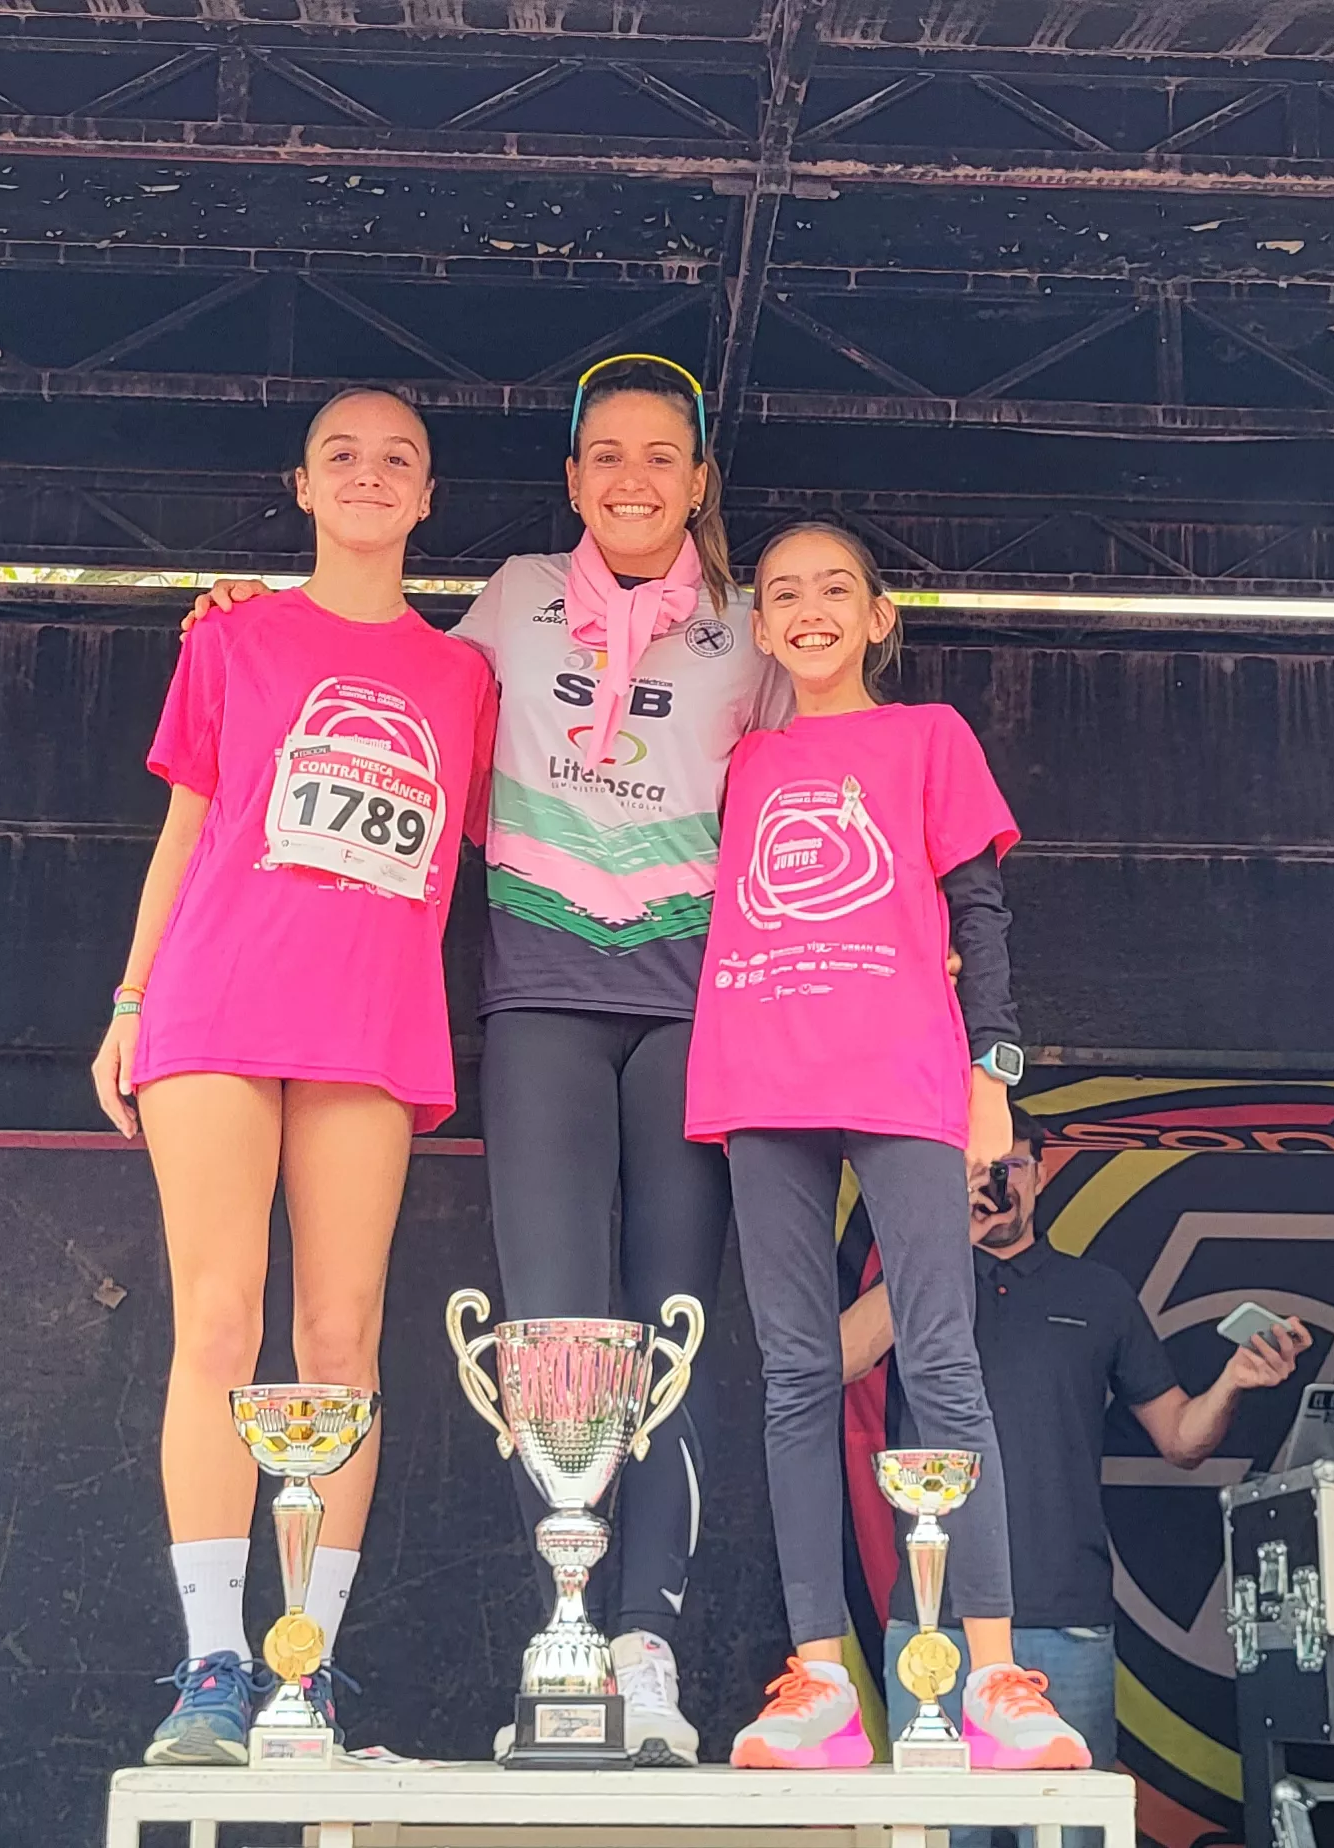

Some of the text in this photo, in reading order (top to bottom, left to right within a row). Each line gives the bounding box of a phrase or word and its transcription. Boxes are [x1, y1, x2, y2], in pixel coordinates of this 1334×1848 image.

[553, 672, 673, 718] SB
[298, 760, 432, 807] CONTRA EL CÁNCER
[351, 756, 393, 777] HUESCA
[292, 781, 426, 855] 1789
[773, 850, 818, 871] JUNTOS
